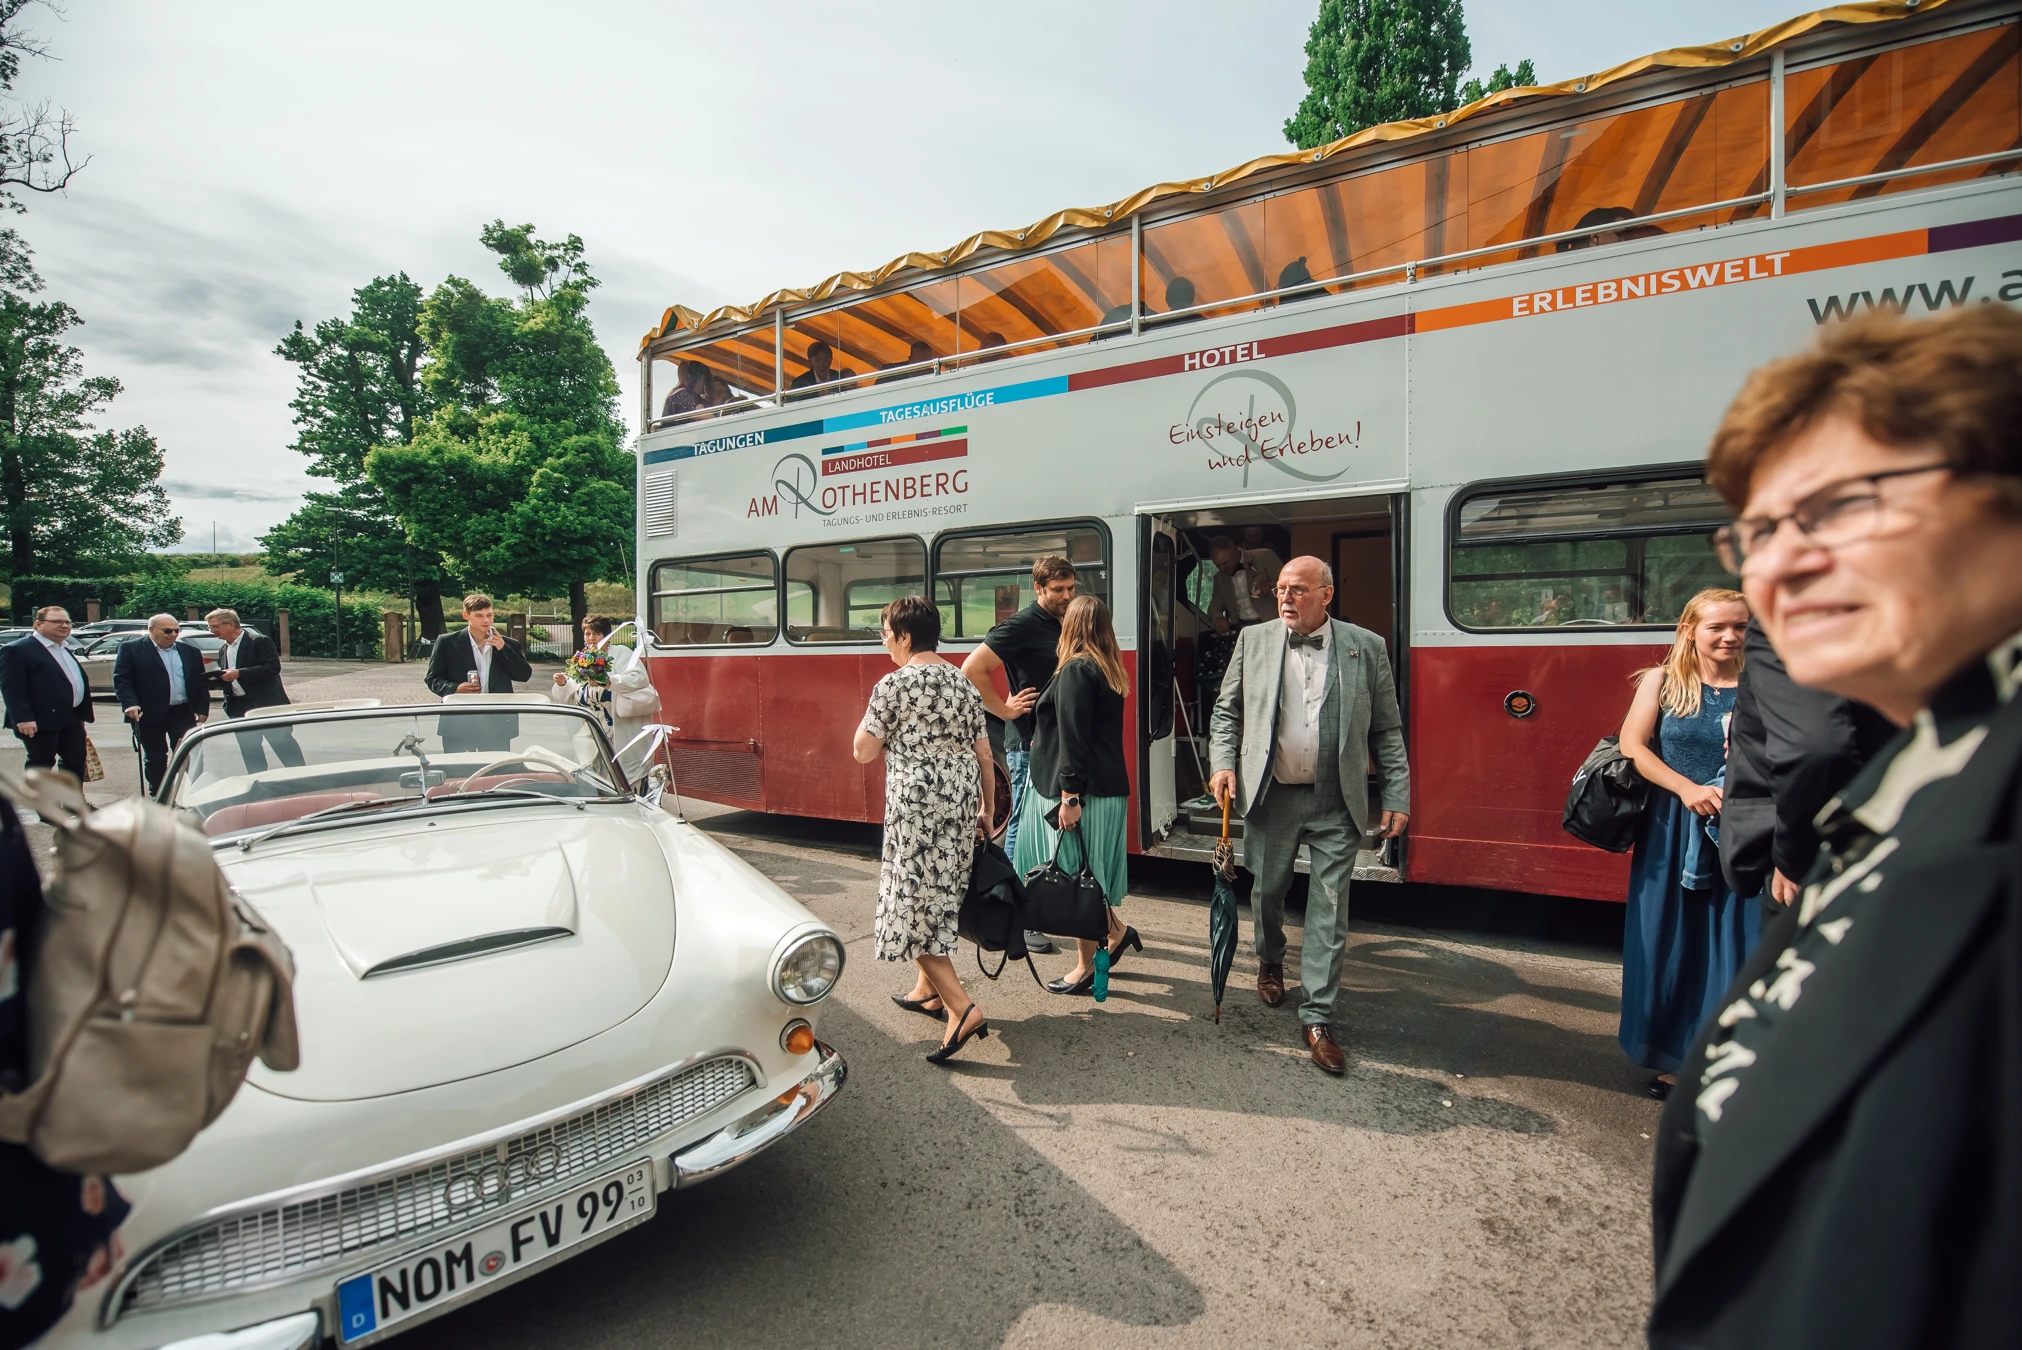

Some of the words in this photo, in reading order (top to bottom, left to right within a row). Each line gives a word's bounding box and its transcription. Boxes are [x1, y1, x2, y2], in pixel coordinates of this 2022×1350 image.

[1512, 251, 1790, 317] ERLEBNISWELT
[1184, 341, 1265, 371] HOTEL
[880, 392, 995, 423] TAGESAUSFLÜGE
[1169, 410, 1284, 446] Einsteigen
[692, 431, 765, 456] TAGUNGEN
[1208, 445, 1251, 471] und
[1261, 421, 1361, 460] Erleben!
[828, 454, 892, 473] LANDHOTEL
[747, 495, 778, 518] AM
[822, 517, 863, 527] TAGUNGS-
[865, 513, 884, 523] UND
[886, 503, 968, 521] ERLEBNIS-RESORT
[627, 1170, 643, 1185] 03
[630, 1196, 645, 1211] 10
[378, 1242, 474, 1319] NOM
[510, 1203, 563, 1263] FV
[577, 1180, 624, 1234] 99
[352, 1313, 365, 1329] D
